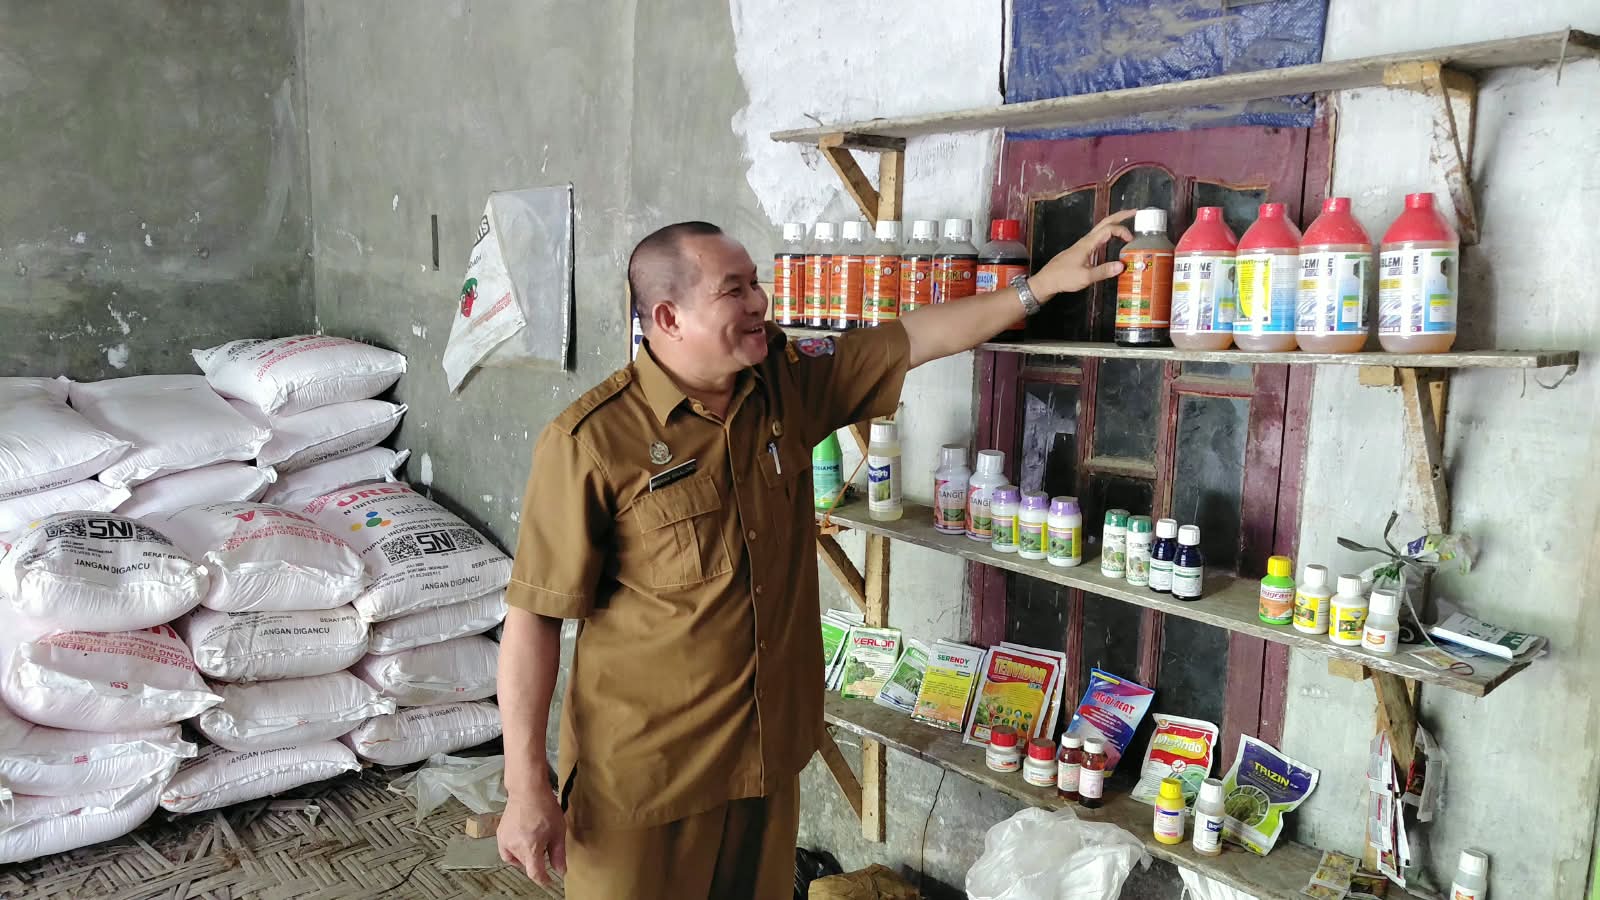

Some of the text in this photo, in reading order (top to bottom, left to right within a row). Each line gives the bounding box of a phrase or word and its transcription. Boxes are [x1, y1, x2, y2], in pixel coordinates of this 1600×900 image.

[88, 519, 134, 540] SNI
[388, 524, 430, 537] INDONESIA
[414, 529, 457, 554] SNI
[74, 559, 150, 575] JANGAN DIGANCU
[420, 580, 449, 591] JANGAN
[450, 575, 480, 587] DIGANCU
[259, 627, 330, 637] JANGAN DIGANCU
[103, 646, 168, 664] BERSUBSIDI
[118, 641, 156, 654] DALAM
[937, 654, 970, 666] SERENDY
[226, 751, 259, 765] JANGAN
[1254, 761, 1290, 788] TRIZIN
